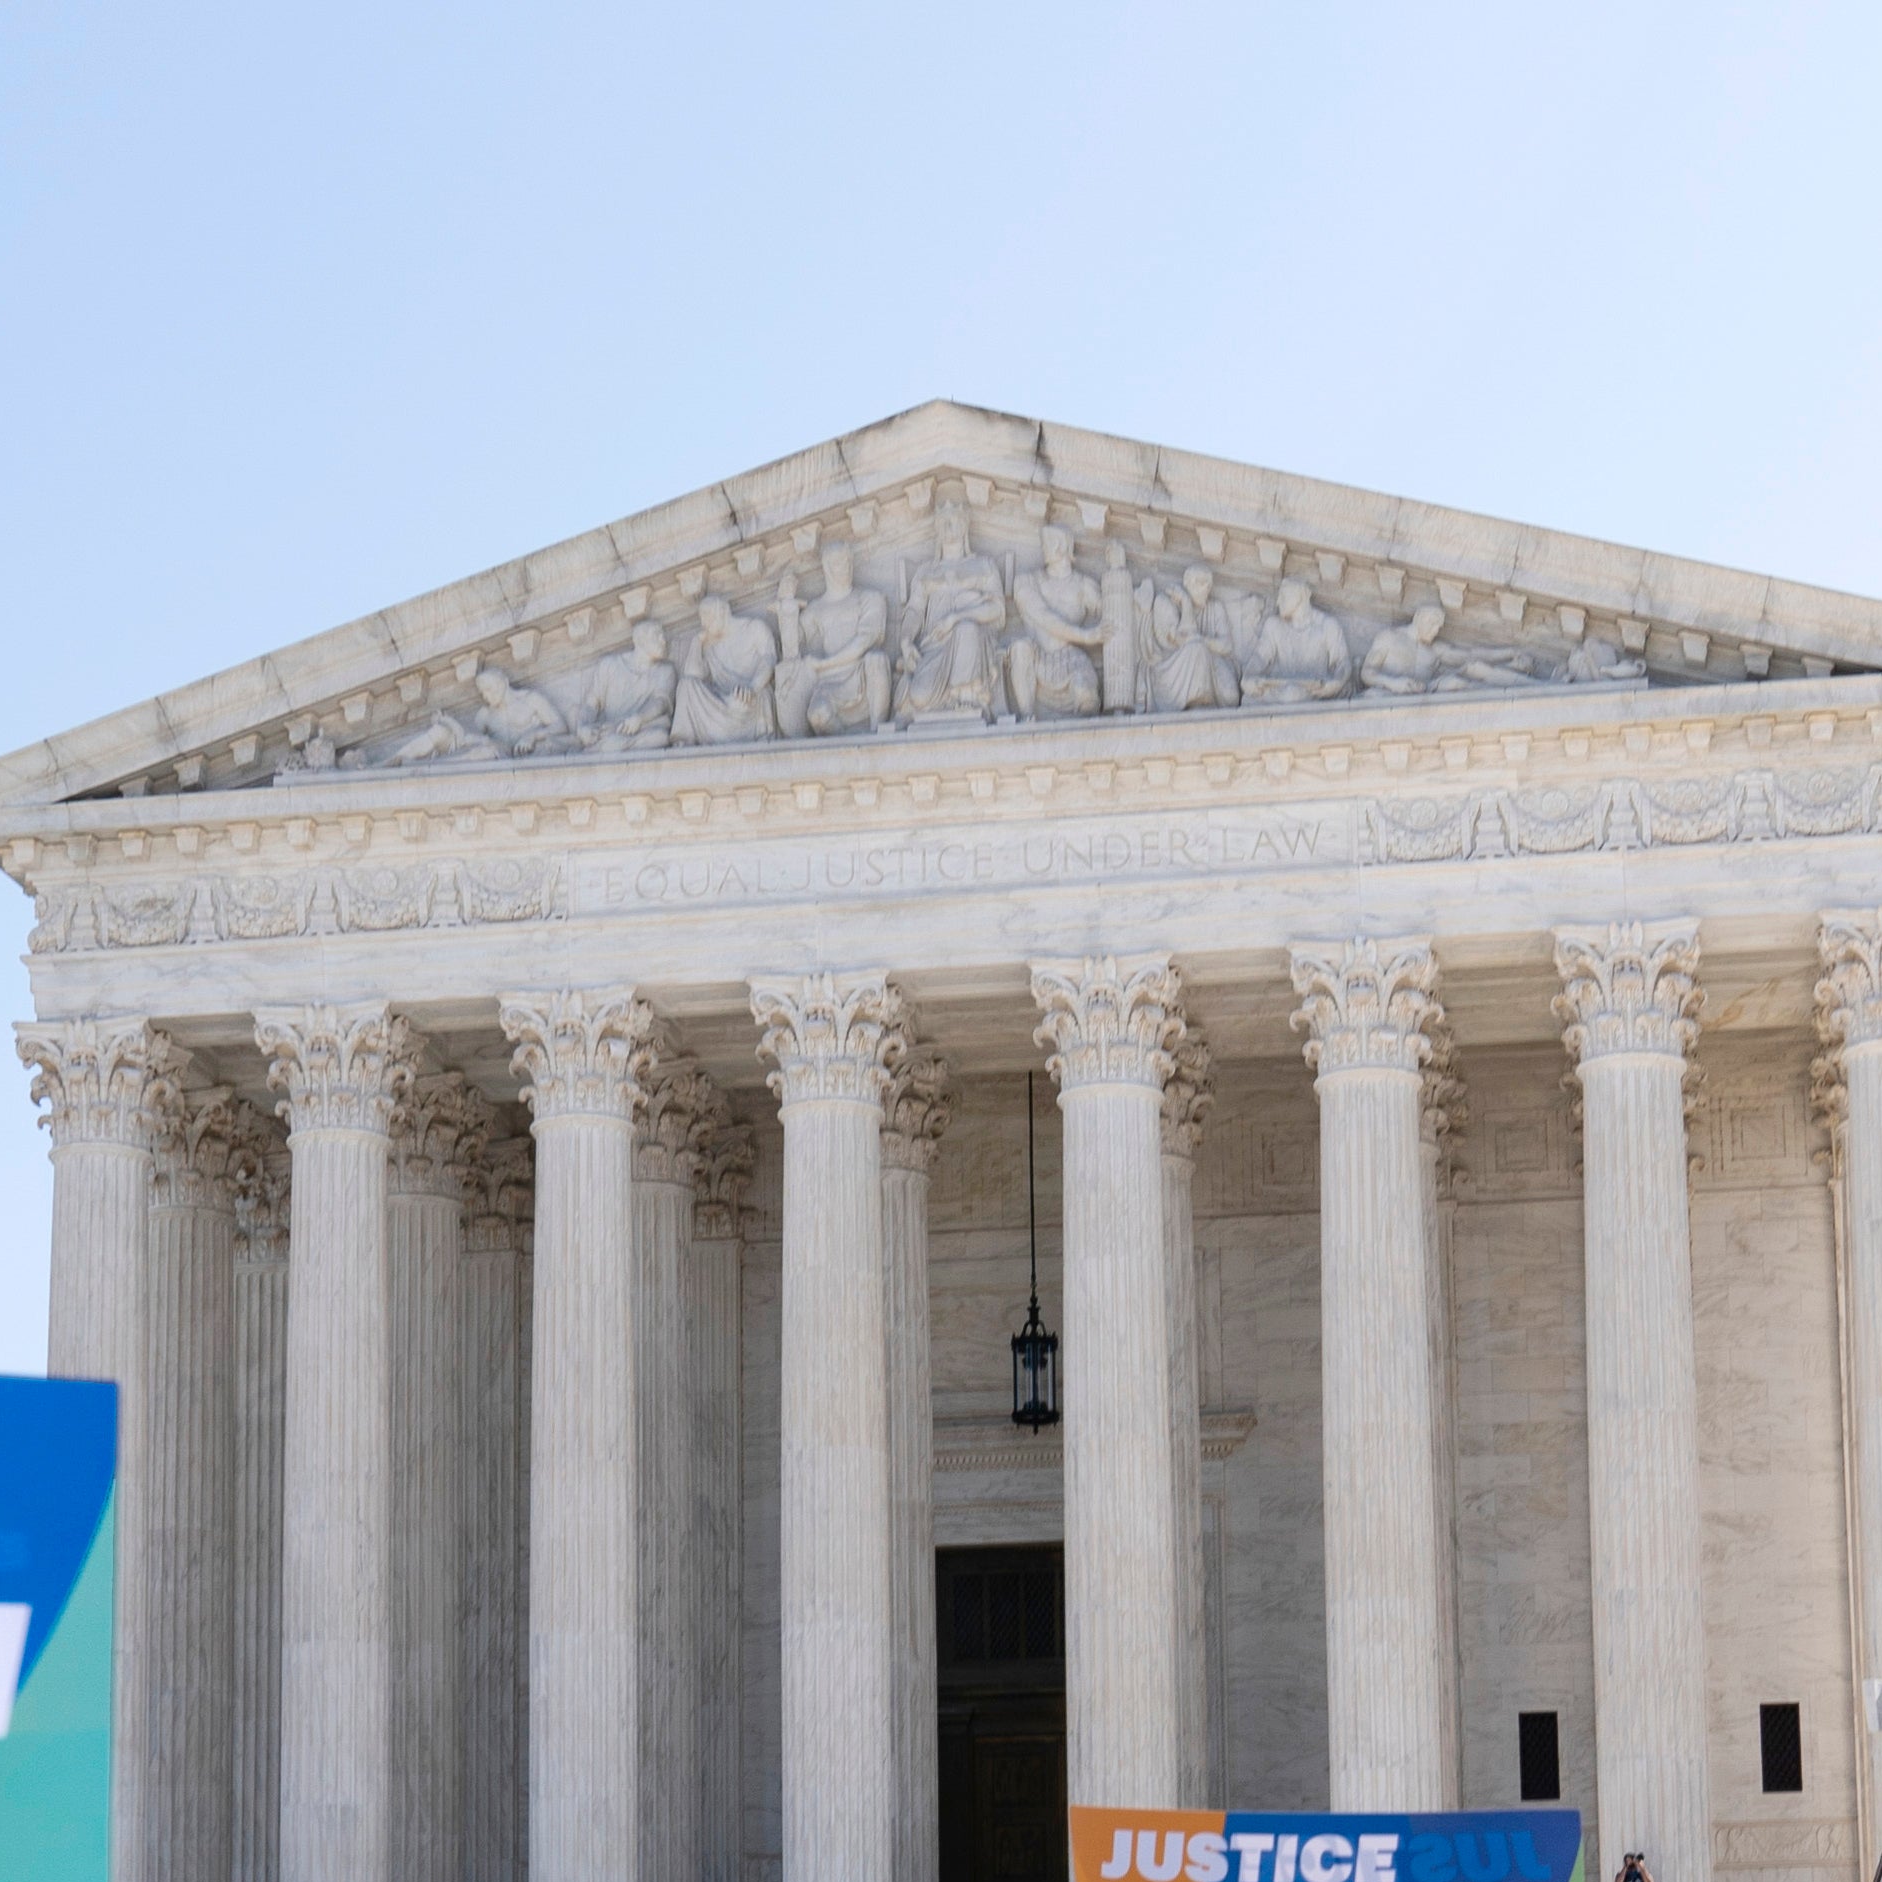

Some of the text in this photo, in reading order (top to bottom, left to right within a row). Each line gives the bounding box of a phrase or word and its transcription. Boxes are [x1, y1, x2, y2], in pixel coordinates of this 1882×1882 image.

[602, 820, 1325, 904] EQUAL JUSTICE UNDER LAW
